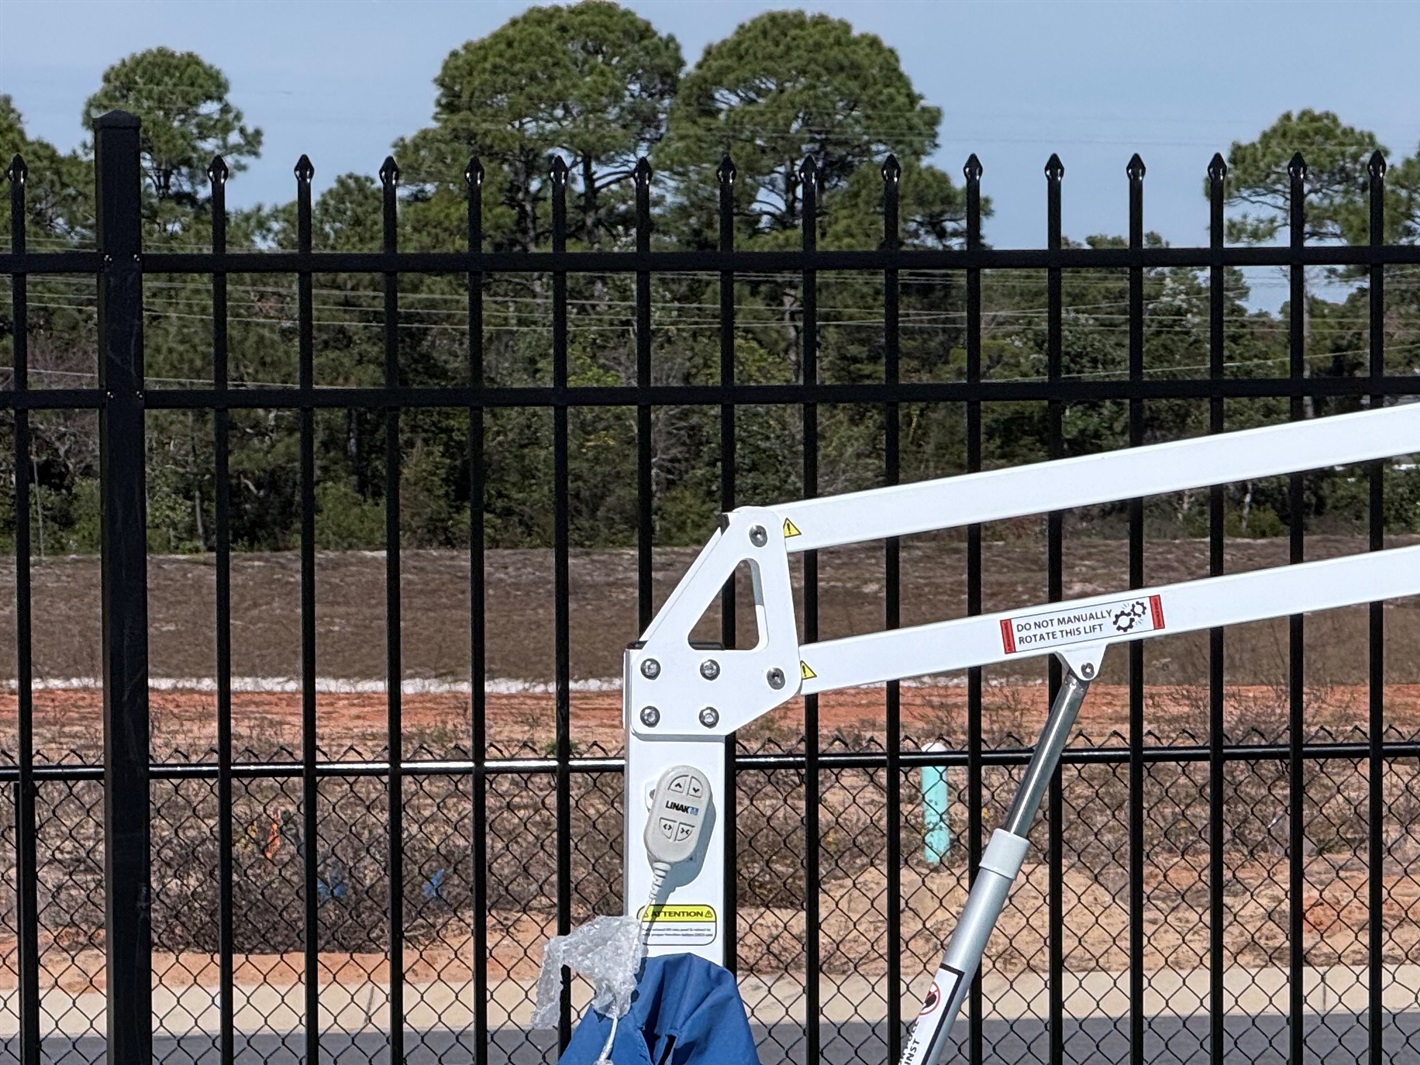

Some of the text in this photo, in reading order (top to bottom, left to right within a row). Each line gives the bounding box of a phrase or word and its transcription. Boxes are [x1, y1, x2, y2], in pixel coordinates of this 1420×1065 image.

[1016, 609, 1113, 633] DO NOT MANUALLY
[1018, 631, 1058, 645] ROTATE
[1059, 627, 1082, 639] THIS
[1084, 623, 1104, 635] LIFT
[665, 800, 689, 814] LINAK
